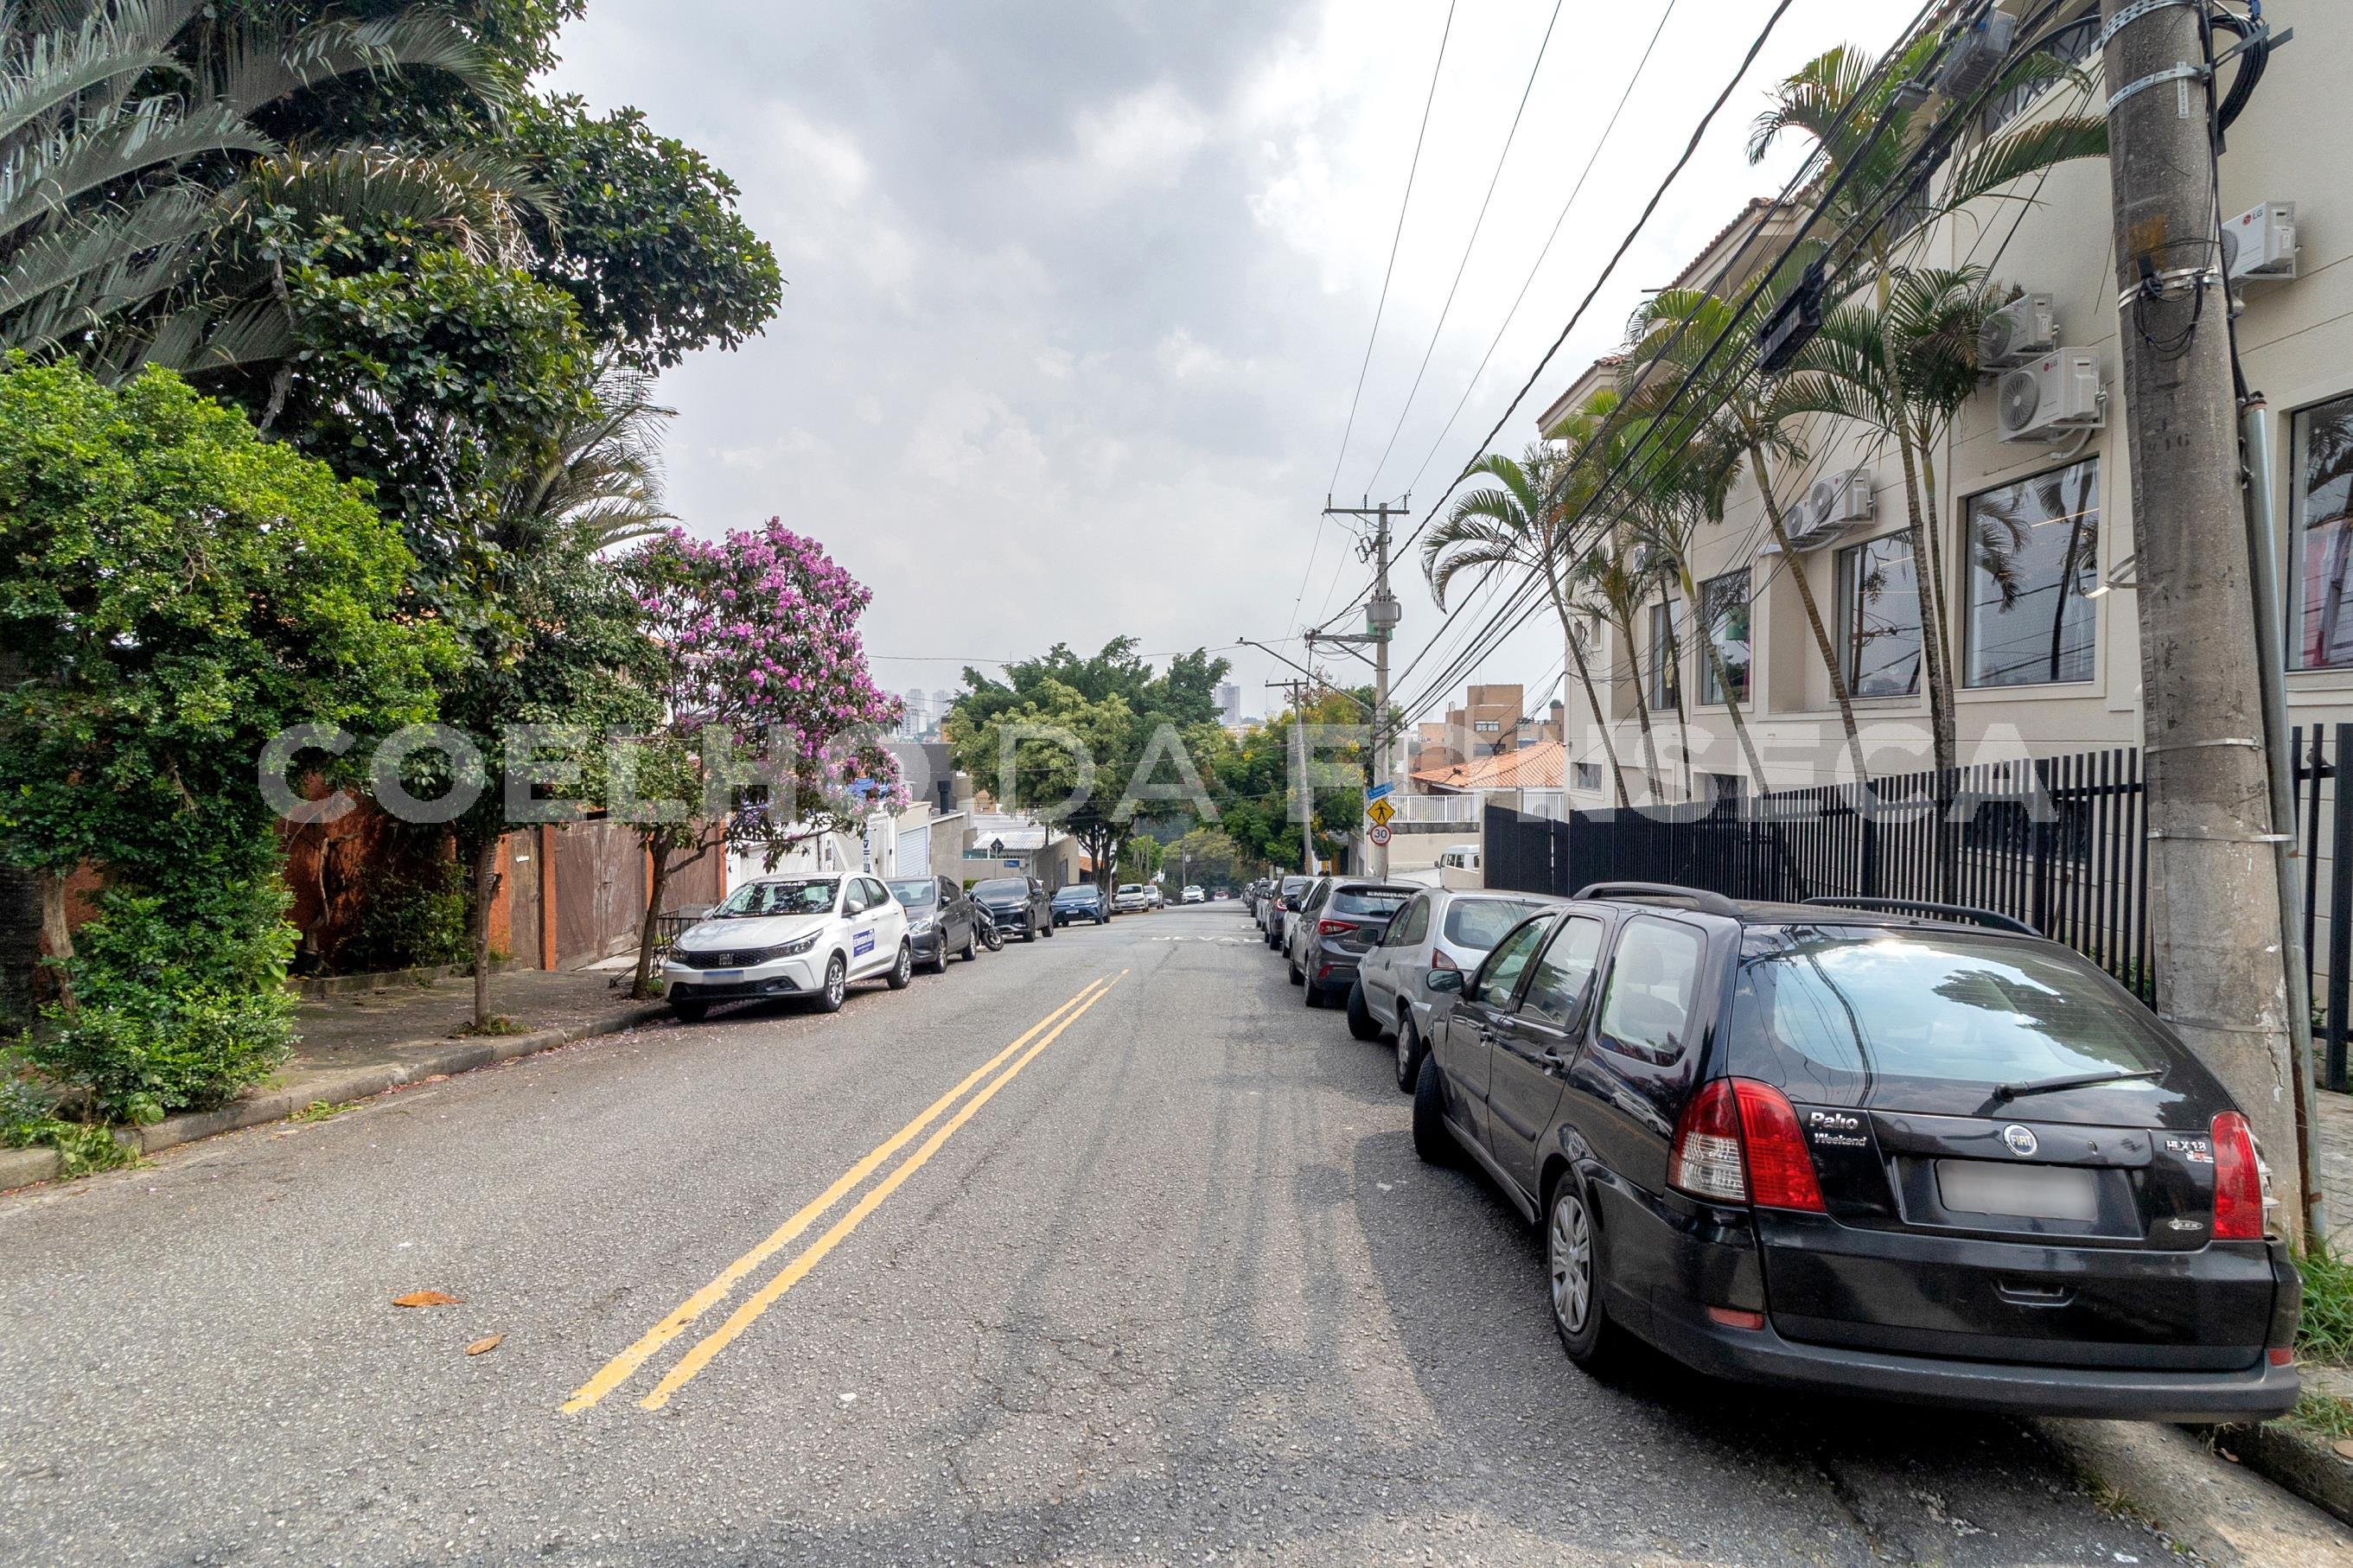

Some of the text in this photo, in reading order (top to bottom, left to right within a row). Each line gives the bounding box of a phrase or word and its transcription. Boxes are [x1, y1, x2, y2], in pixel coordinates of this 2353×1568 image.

[2253, 209, 2263, 220] LG
[2050, 359, 2058, 369] LG
[1374, 829, 1387, 838] 30
[1809, 1112, 1859, 1130] Palio
[1814, 1132, 1867, 1146] Weekend
[2010, 1134, 2031, 1147] FIAT
